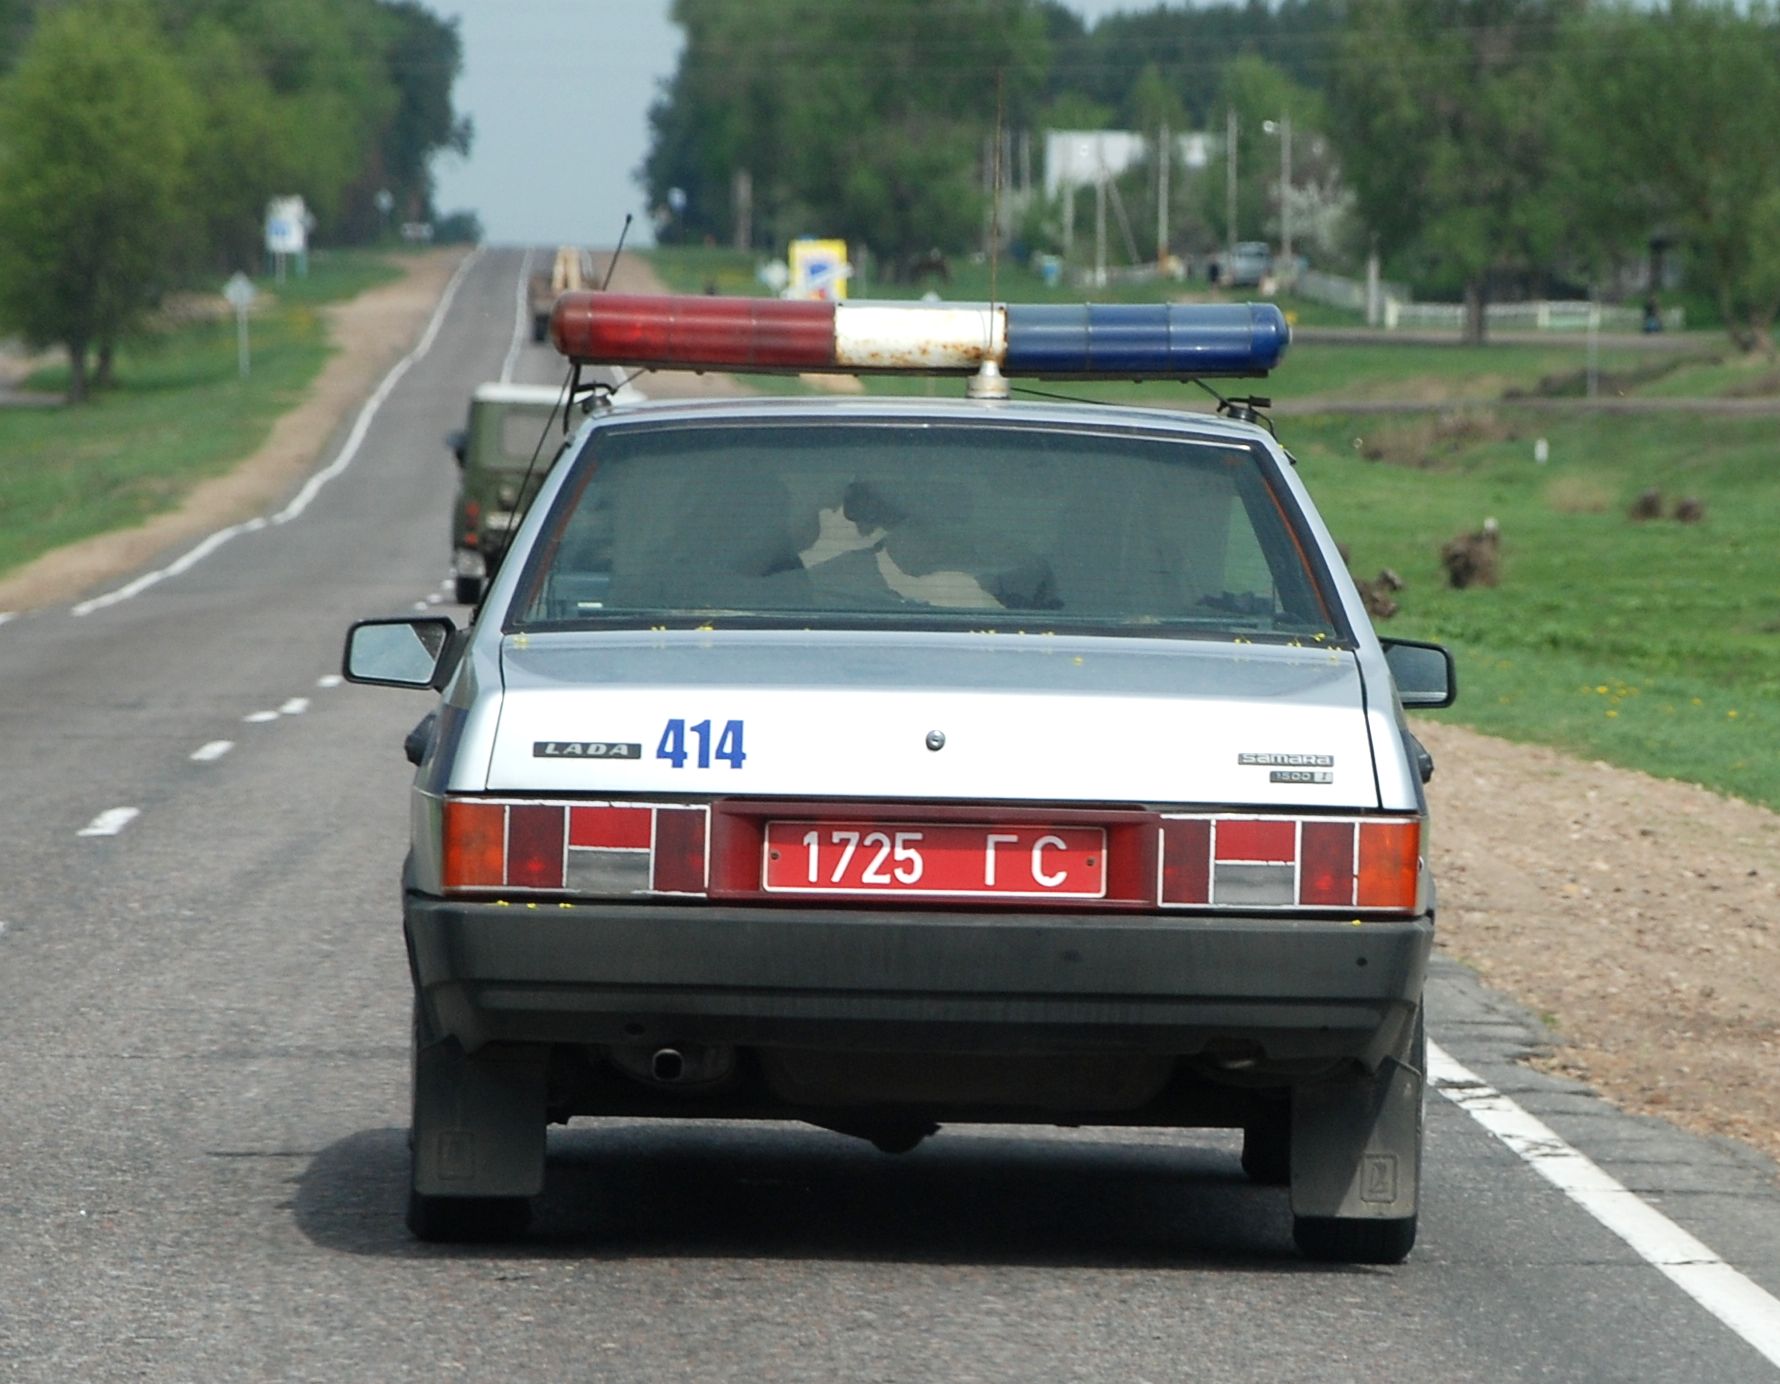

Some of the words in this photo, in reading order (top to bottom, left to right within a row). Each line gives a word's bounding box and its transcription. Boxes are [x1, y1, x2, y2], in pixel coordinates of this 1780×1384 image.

[544, 743, 629, 756] LADA
[656, 719, 746, 769] 414
[803, 831, 924, 884] 1725
